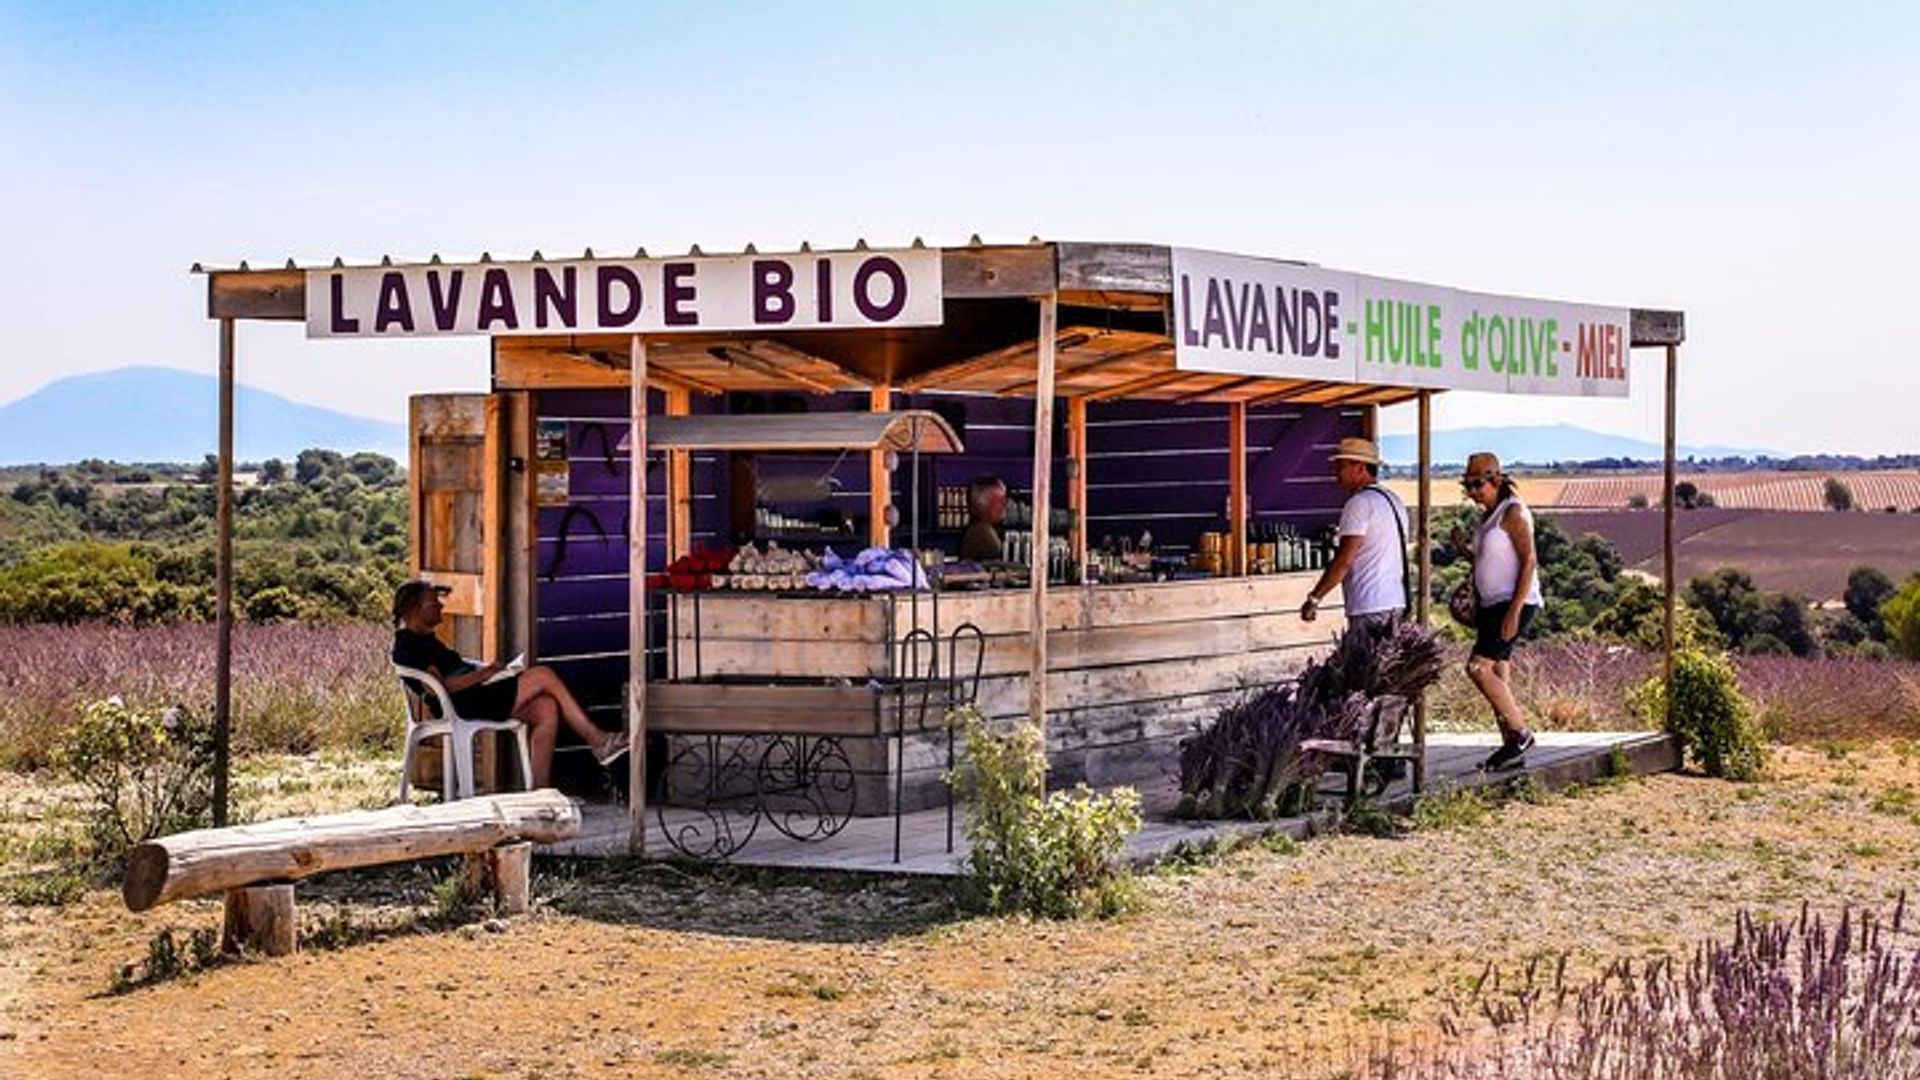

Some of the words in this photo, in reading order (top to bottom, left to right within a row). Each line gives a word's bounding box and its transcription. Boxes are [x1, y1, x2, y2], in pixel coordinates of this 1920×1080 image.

[331, 262, 699, 333] LAVANDE
[753, 256, 908, 325] BIO
[1181, 273, 1341, 360] LAVANDE
[1365, 299, 1443, 369] HUILE
[1461, 310, 1559, 377] d'OLIVE
[1575, 322, 1627, 381] MIEL
